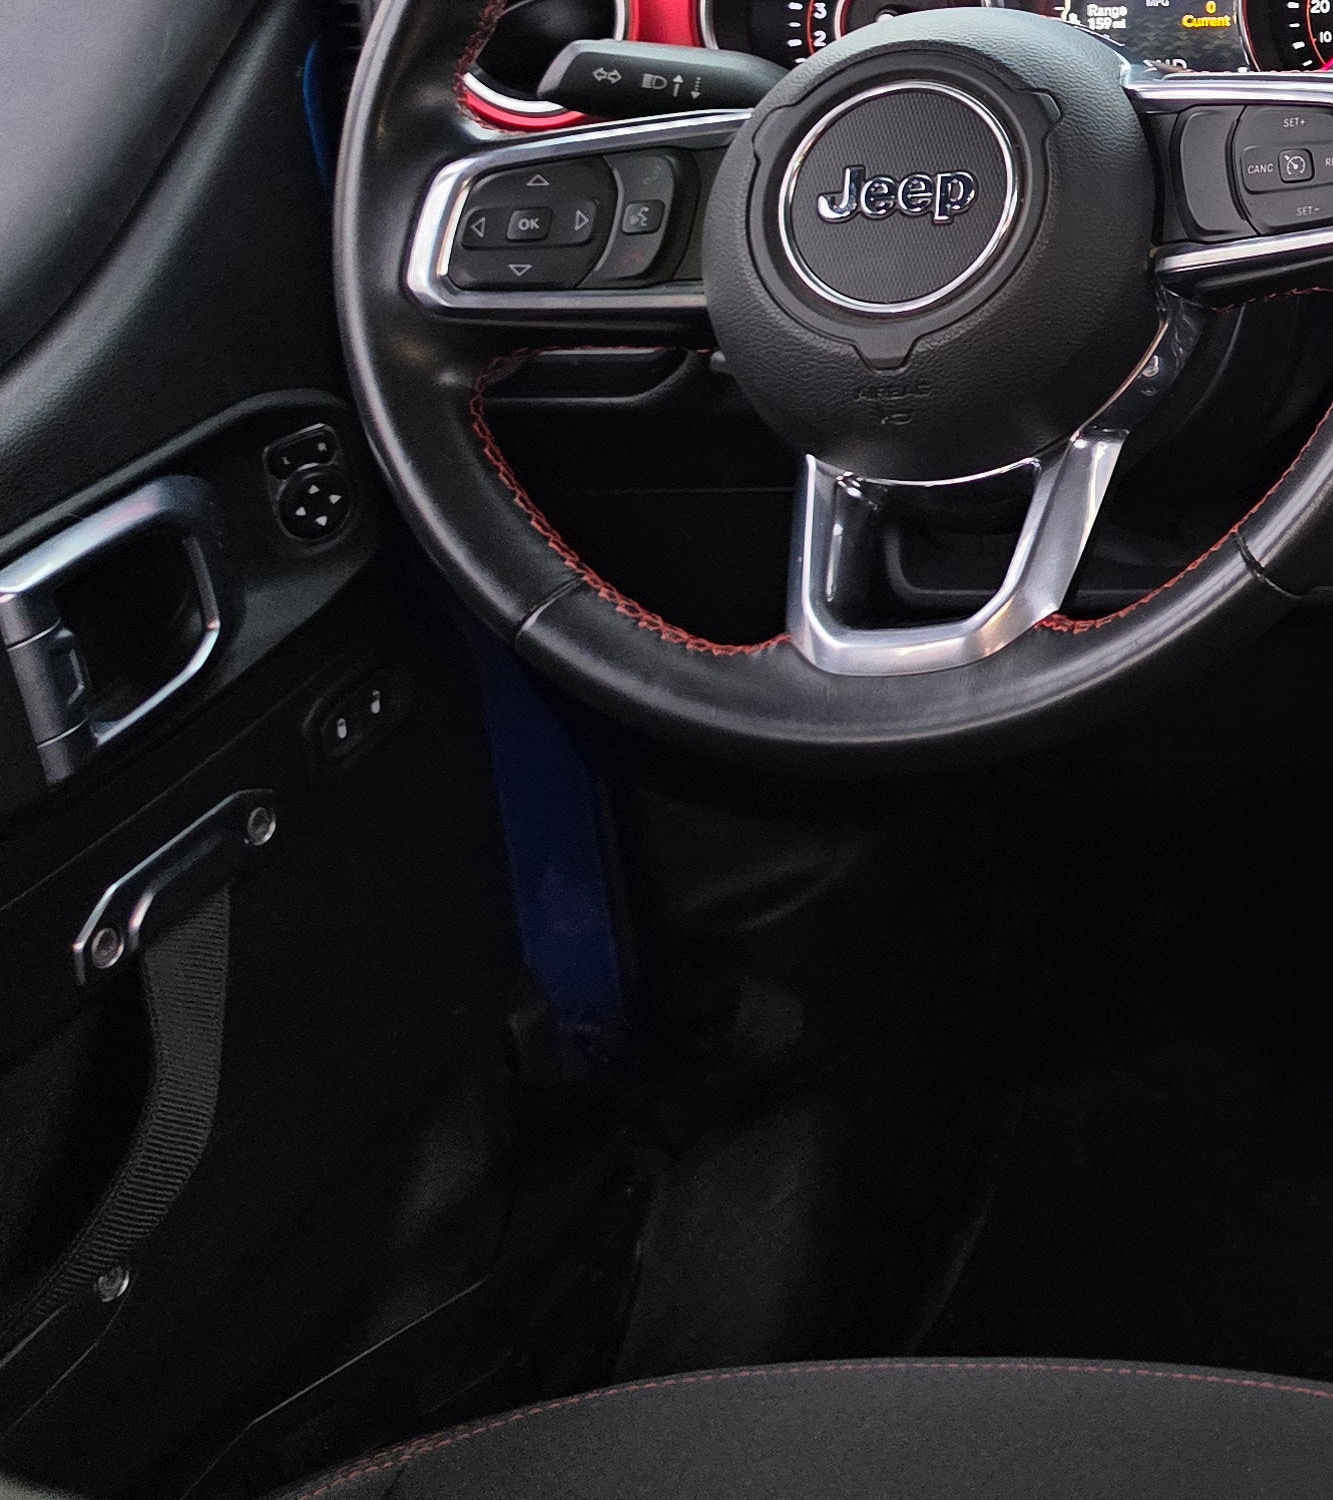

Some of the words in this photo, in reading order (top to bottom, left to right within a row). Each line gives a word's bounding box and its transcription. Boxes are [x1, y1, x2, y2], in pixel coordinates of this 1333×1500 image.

[812, 2, 827, 19] 3
[1086, 4, 1128, 18] Range
[1205, 0, 1217, 13] 0
[1310, 0, 1331, 13] 20
[1087, 17, 1112, 31] 159
[1181, 14, 1231, 29] Current
[813, 30, 827, 47] 2
[1320, 31, 1333, 43] 10
[1283, 116, 1306, 129] SET+
[1247, 161, 1275, 176] CANC
[816, 164, 977, 224] Jeep
[518, 216, 540, 231] OK
